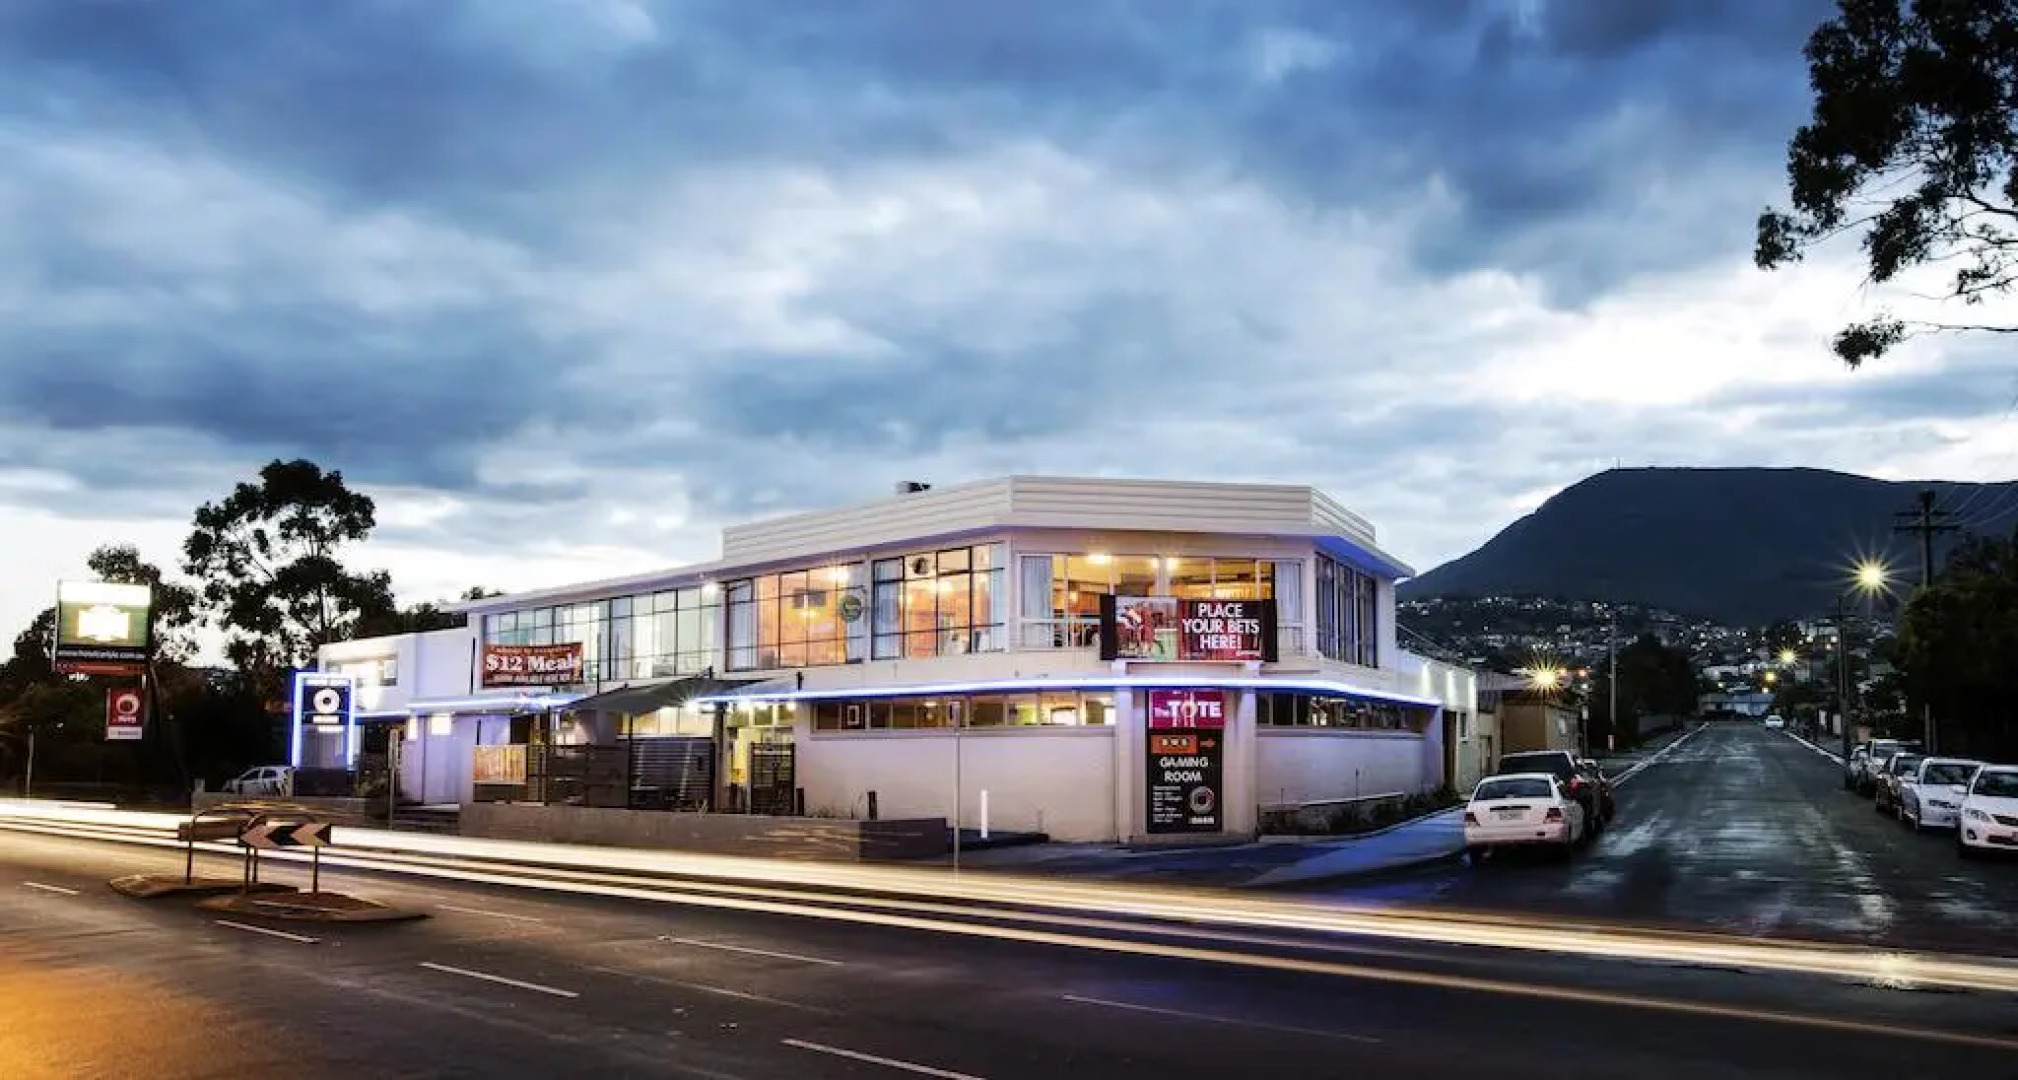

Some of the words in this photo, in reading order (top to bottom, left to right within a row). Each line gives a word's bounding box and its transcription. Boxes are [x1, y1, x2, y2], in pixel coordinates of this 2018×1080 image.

[1197, 602, 1244, 618] PLACE
[1182, 618, 1224, 634] YOUR
[1227, 618, 1260, 634] BETS
[1200, 634, 1242, 649] HERE!
[486, 652, 523, 672] $12
[1166, 700, 1222, 718] TOTE
[1160, 756, 1209, 769] GAMING
[1164, 770, 1203, 783] ROOM
